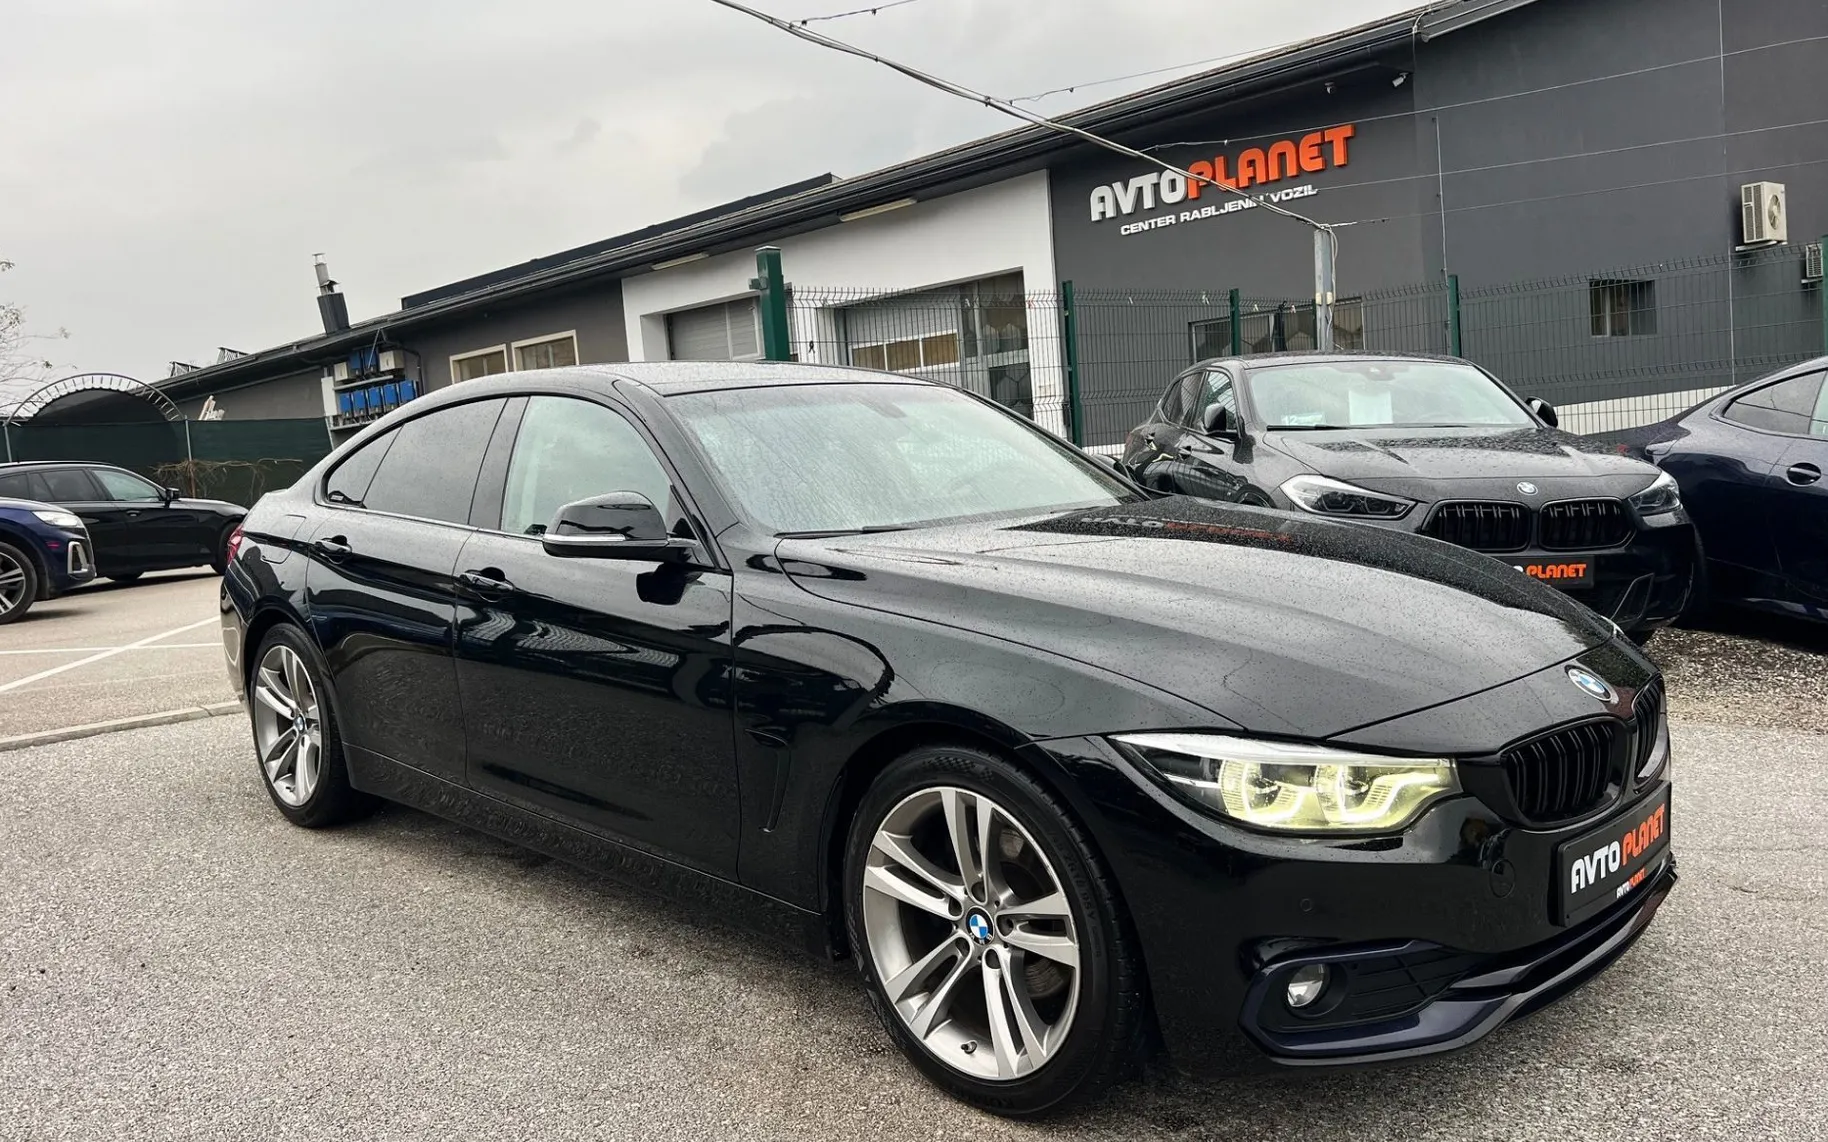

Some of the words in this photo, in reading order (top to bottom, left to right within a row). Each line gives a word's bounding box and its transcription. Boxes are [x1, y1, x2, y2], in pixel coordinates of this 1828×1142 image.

[1121, 215, 1176, 235] CENTER
[1269, 184, 1318, 203] VOZIL
[1526, 563, 1587, 579] PLANET
[1571, 840, 1621, 894] AVTO
[1622, 803, 1665, 866] PLANET
